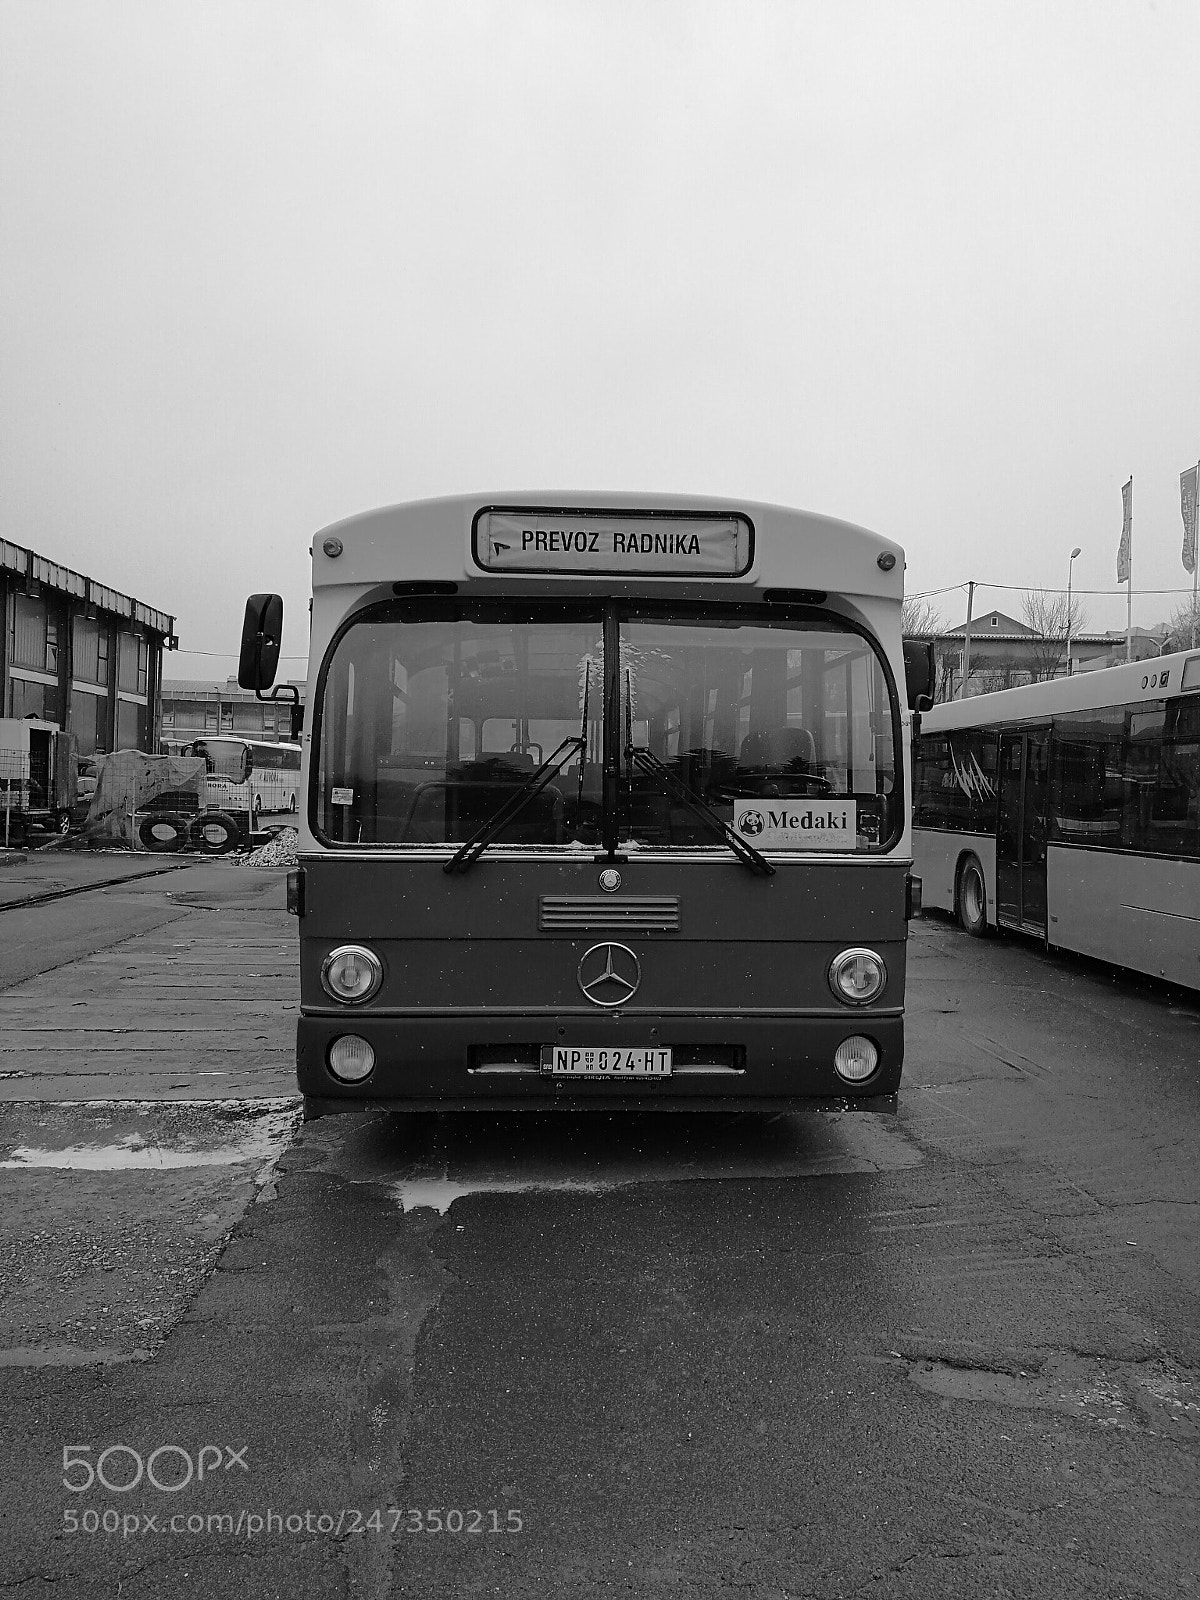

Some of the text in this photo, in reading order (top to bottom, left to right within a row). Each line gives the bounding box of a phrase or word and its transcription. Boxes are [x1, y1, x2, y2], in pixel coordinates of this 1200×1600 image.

[521, 530, 701, 555] PREVOZ RADNIKA
[766, 810, 848, 830] Medaki
[557, 1050, 581, 1071] NP
